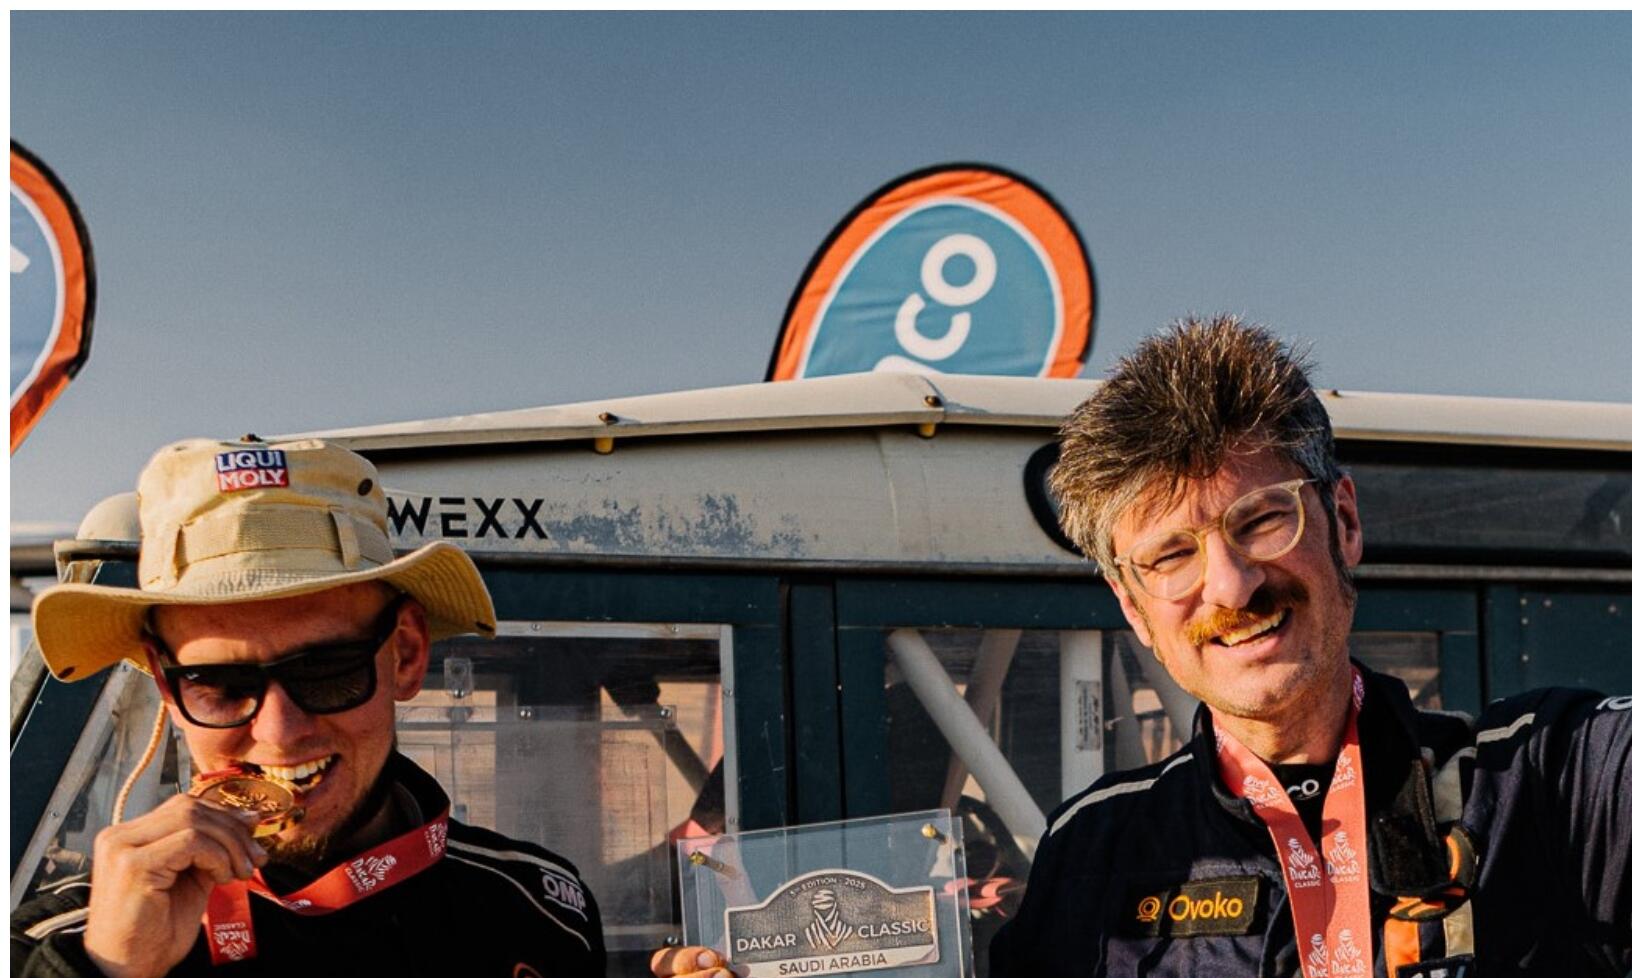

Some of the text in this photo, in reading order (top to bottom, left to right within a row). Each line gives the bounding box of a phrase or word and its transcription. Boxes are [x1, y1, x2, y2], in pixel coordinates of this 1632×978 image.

[874, 233, 997, 374] co
[216, 451, 283, 472] LIQUI
[219, 468, 286, 491] MOLY
[386, 497, 548, 539] WEXX
[1169, 892, 1243, 921] Ovoko
[736, 920, 929, 953] DAKAR CLASSIC
[779, 953, 887, 976] SAUDI ARABIA
